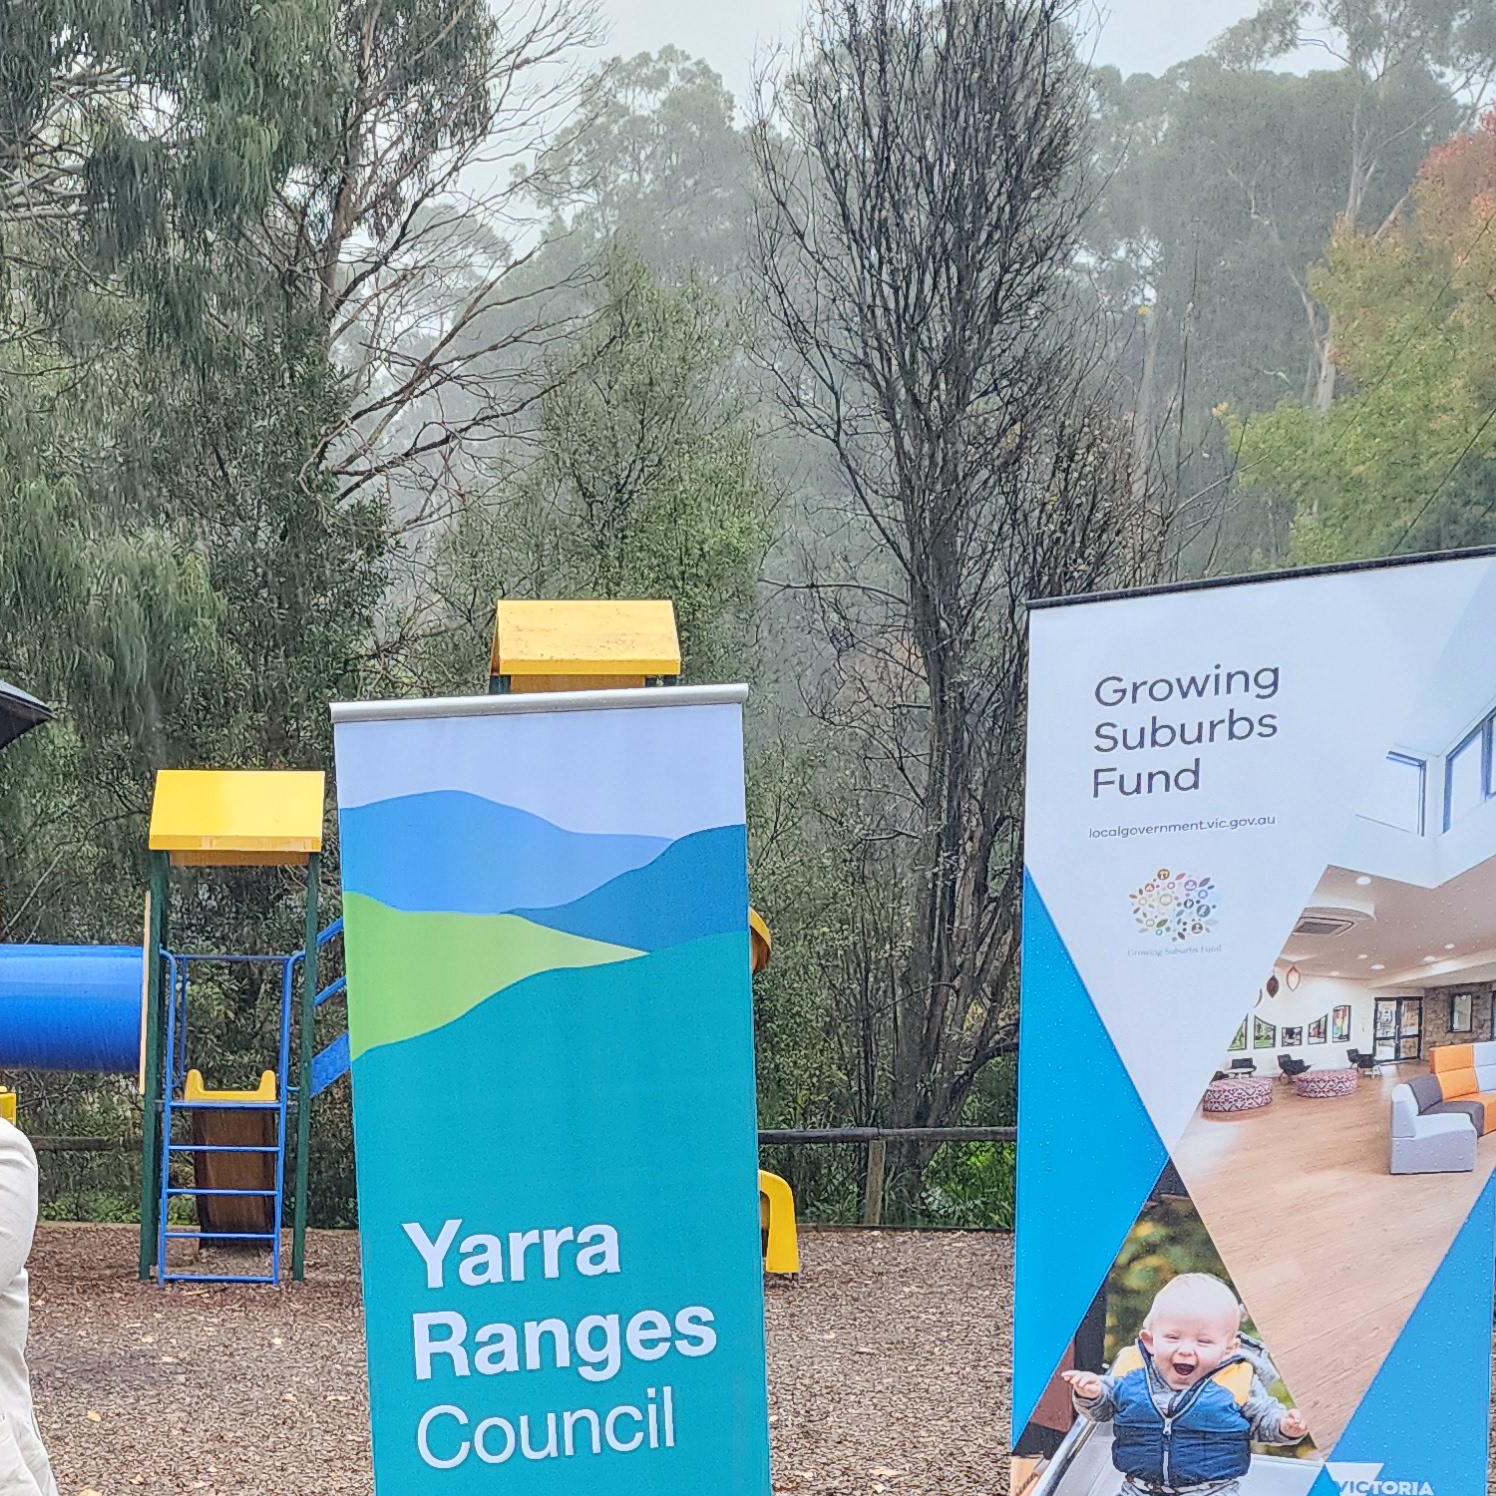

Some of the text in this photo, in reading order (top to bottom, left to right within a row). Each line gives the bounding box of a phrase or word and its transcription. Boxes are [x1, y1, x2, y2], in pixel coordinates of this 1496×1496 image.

[1094, 663, 1280, 706] Growing
[1093, 708, 1279, 752] Suburbs
[1092, 757, 1201, 799] Fund
[1088, 816, 1276, 839] localgovernment.vic.gov.au
[402, 1218, 621, 1289] Yarra
[412, 1305, 717, 1382] Ranges
[416, 1386, 675, 1469] Council
[1335, 1480, 1435, 1496] VICTORIA
